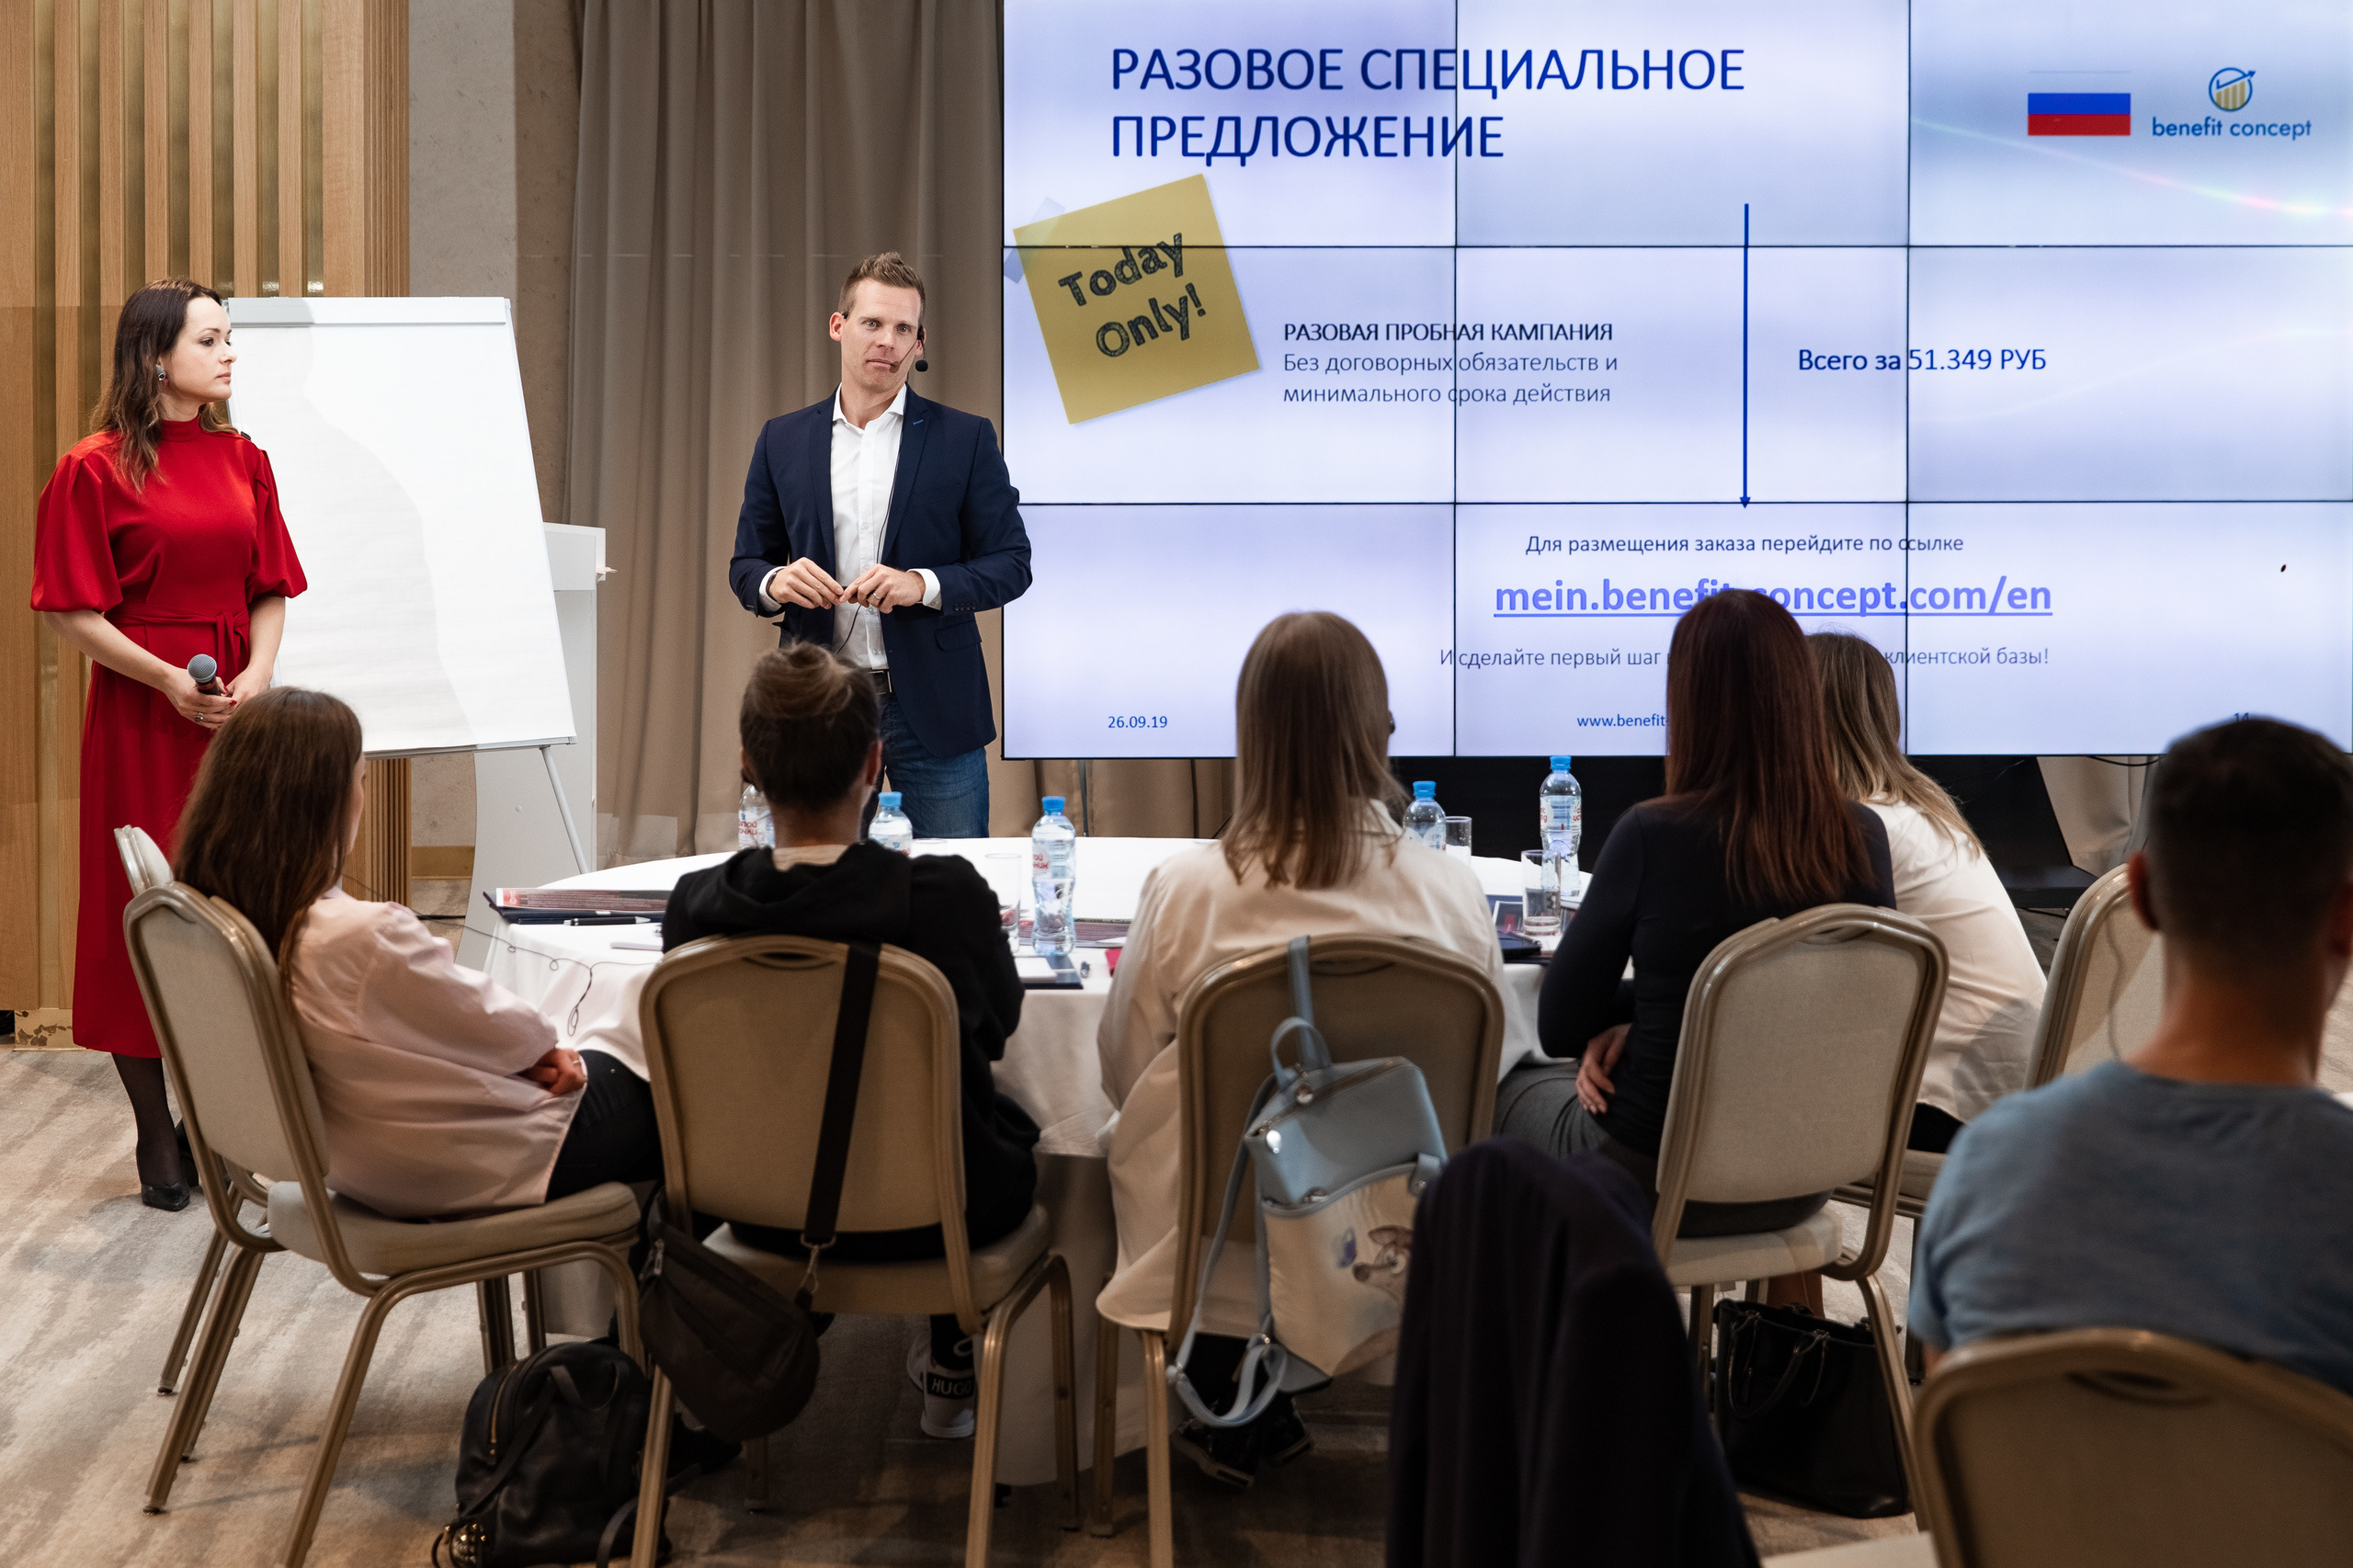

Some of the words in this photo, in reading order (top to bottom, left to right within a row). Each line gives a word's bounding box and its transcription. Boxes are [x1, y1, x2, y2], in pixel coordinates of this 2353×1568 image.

[1112, 49, 1345, 90] РАЗОВОЕ
[1360, 49, 1745, 99] СПЕЦИАЛЬНОЕ
[2152, 116, 2222, 137] benefit
[2229, 119, 2313, 142] concept
[1112, 115, 1505, 167] ПРЕДЛОЖЕНИЕ
[1058, 233, 1184, 307] Today
[1096, 282, 1206, 358] Only!
[1284, 324, 1379, 341] РАЗОВАЯ
[1385, 324, 1484, 341] ПРОБНАЯ
[1492, 324, 1613, 341] КАМПАНИЯ
[1284, 354, 1319, 371] Без
[1324, 357, 1454, 376] договорных
[1459, 352, 1598, 371] обязательств
[1606, 358, 1618, 371] и
[1799, 349, 1869, 370] Всего
[1875, 355, 1902, 370] за
[1909, 349, 1993, 370] 51.349
[2001, 349, 2047, 370] РУБ
[1283, 388, 1441, 403] минимального
[1448, 388, 1506, 406] срока
[1512, 382, 1610, 405] действия
[1525, 535, 1562, 555] Для
[1569, 540, 1688, 555] размещения
[1695, 540, 1756, 552] заказа
[1763, 535, 1864, 555] перейдите
[1870, 539, 1893, 551] по
[1898, 539, 1964, 551] ссылке
[1440, 649, 1453, 665] И
[1459, 648, 1545, 669] сделайте
[1551, 648, 1620, 669] первый
[1627, 653, 1662, 665] шаг
[1884, 647, 1991, 665] клиентской
[1996, 646, 2049, 665] базы!
[1108, 715, 1168, 729] 26.09.19
[931, 1378, 972, 1395] HUGO
